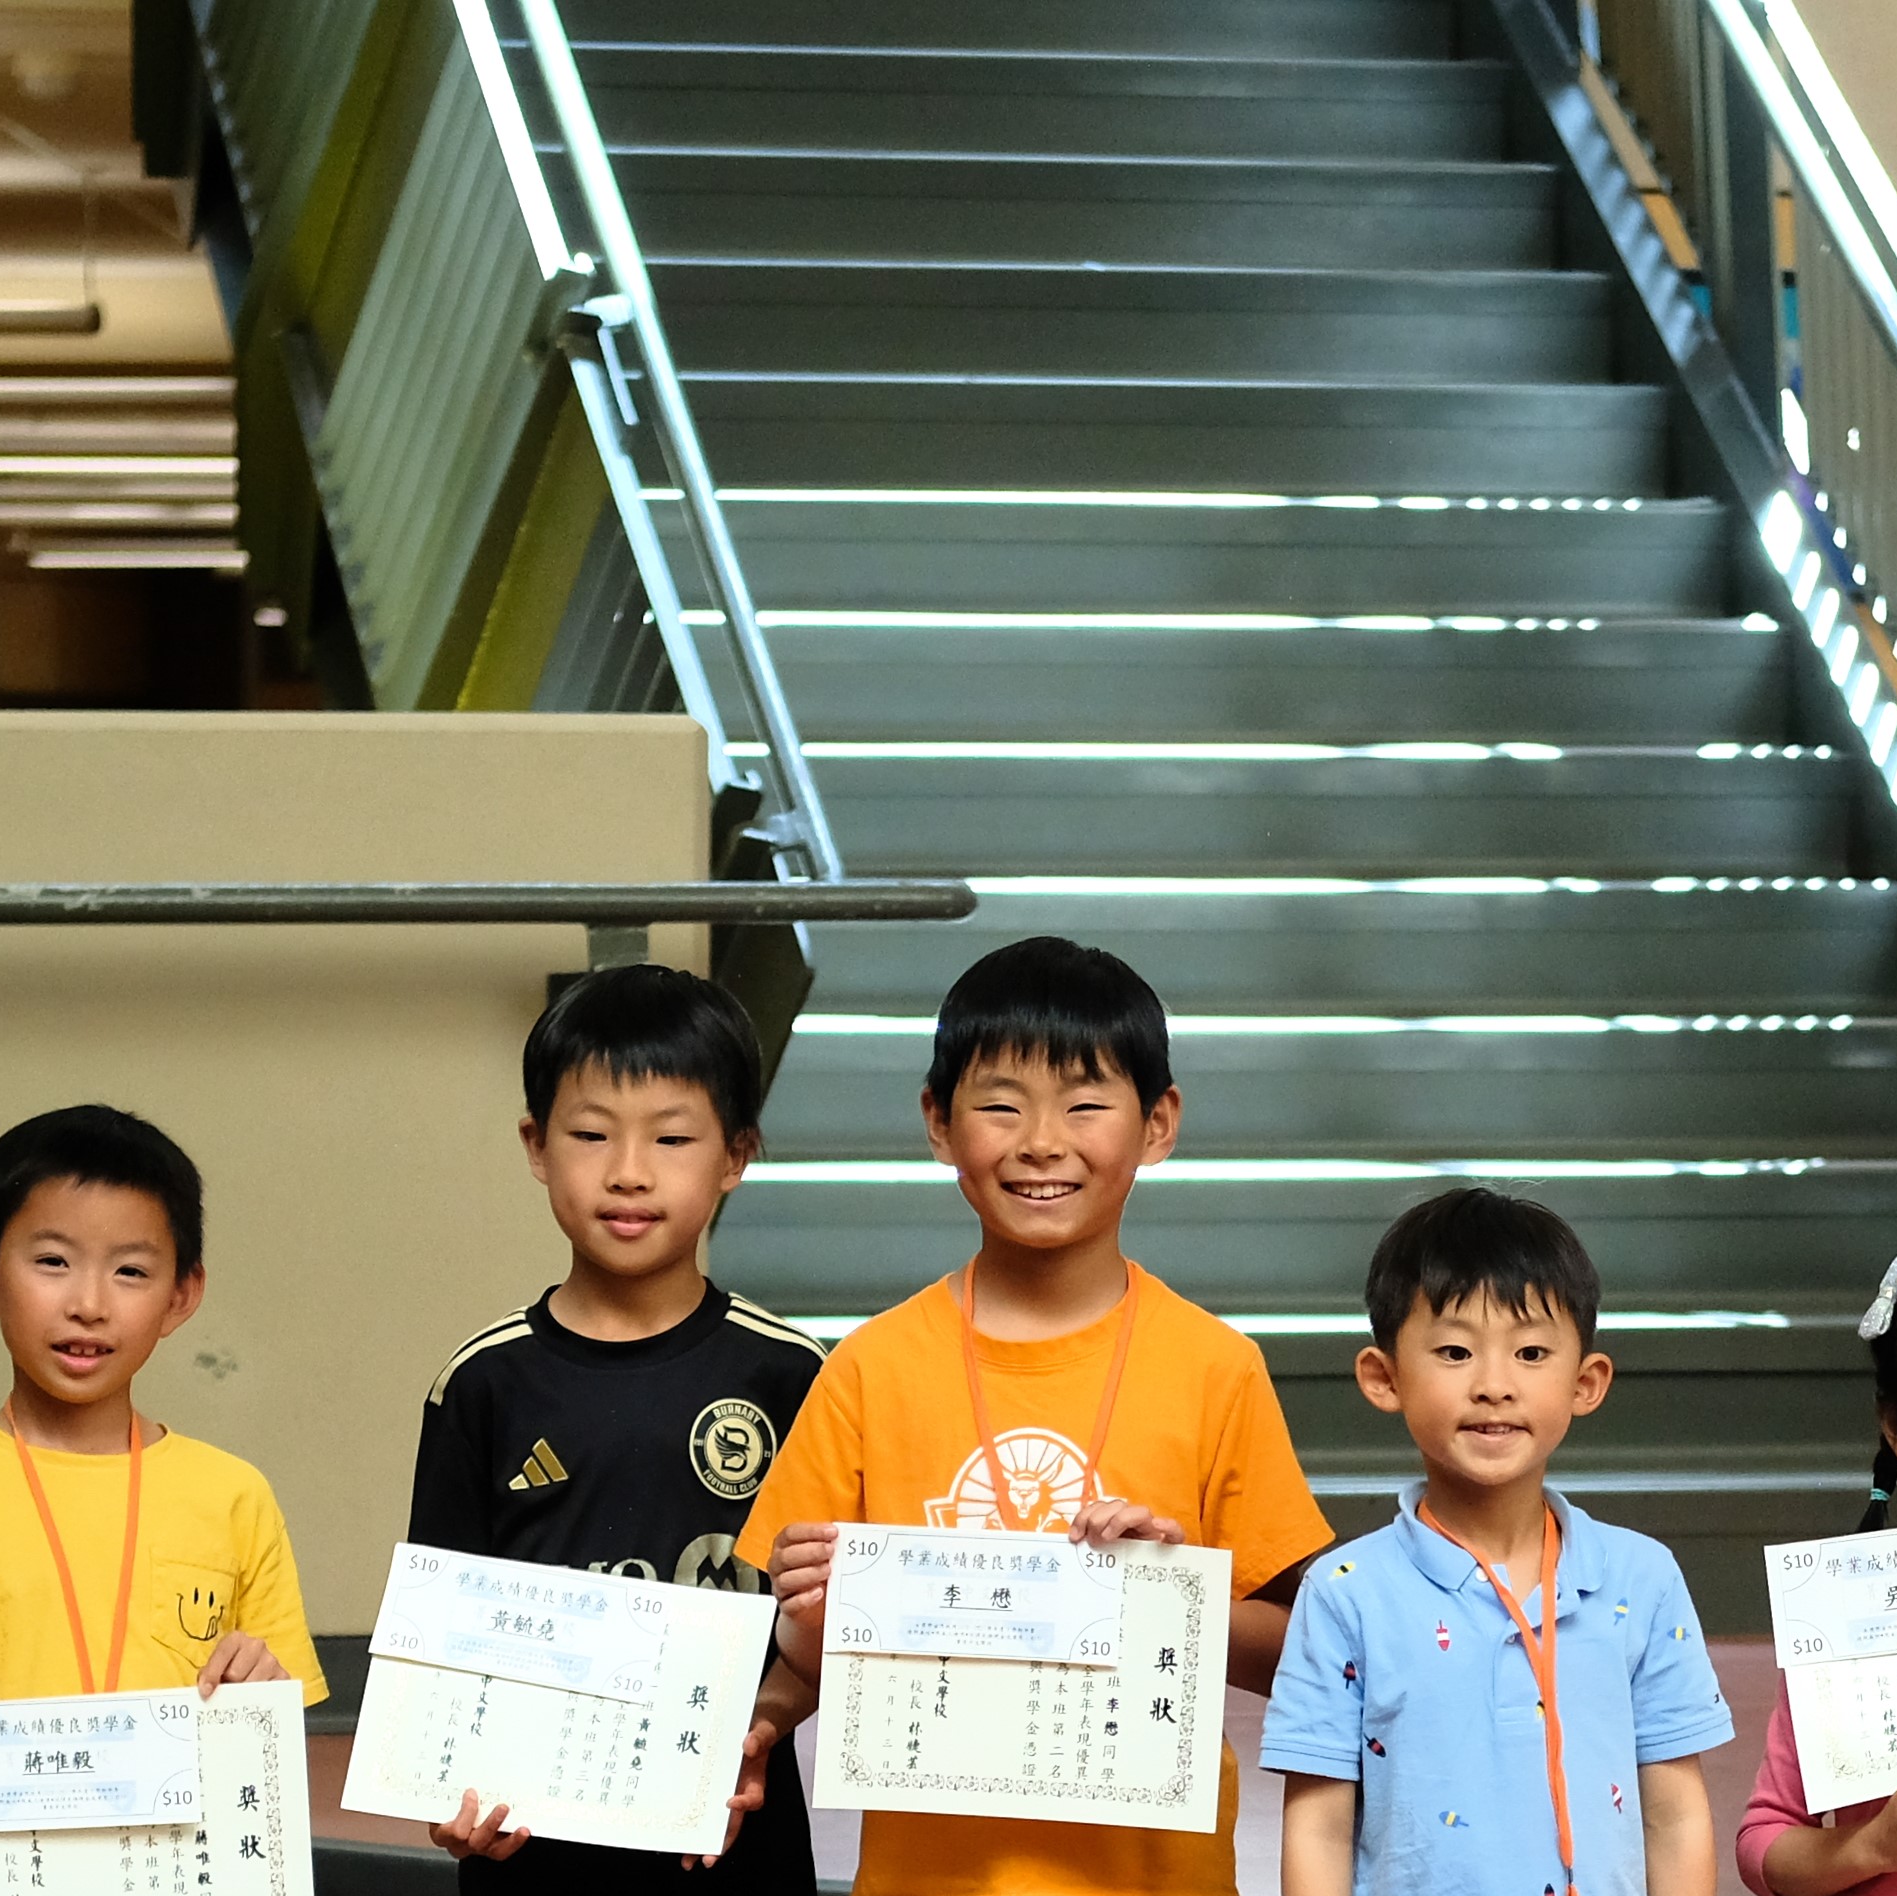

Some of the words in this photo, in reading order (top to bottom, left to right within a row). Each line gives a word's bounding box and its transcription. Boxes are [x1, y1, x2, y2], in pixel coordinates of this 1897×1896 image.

[712, 1404, 761, 1425] BURNABY
[703, 1468, 738, 1494] FOOTBALL
[847, 1540, 878, 1556] $10
[408, 1554, 438, 1573] $10
[898, 1550, 1062, 1573] 學業成績優良獎學金
[1084, 1552, 1116, 1568] $10
[1784, 1552, 1813, 1569] $10
[456, 1571, 609, 1613] 學業成績優良獎學金
[632, 1597, 662, 1615] $10
[389, 1632, 419, 1650] $10
[841, 1627, 872, 1643] $10
[1080, 1640, 1110, 1656] $10
[1793, 1637, 1823, 1653] $10
[613, 1675, 643, 1692] $10
[1150, 1647, 1177, 1724] 獎狀
[159, 1704, 189, 1720] $10
[676, 1685, 708, 1755] 獎狀
[162, 1790, 192, 1806] $10
[237, 1785, 266, 1859] 獎狀
